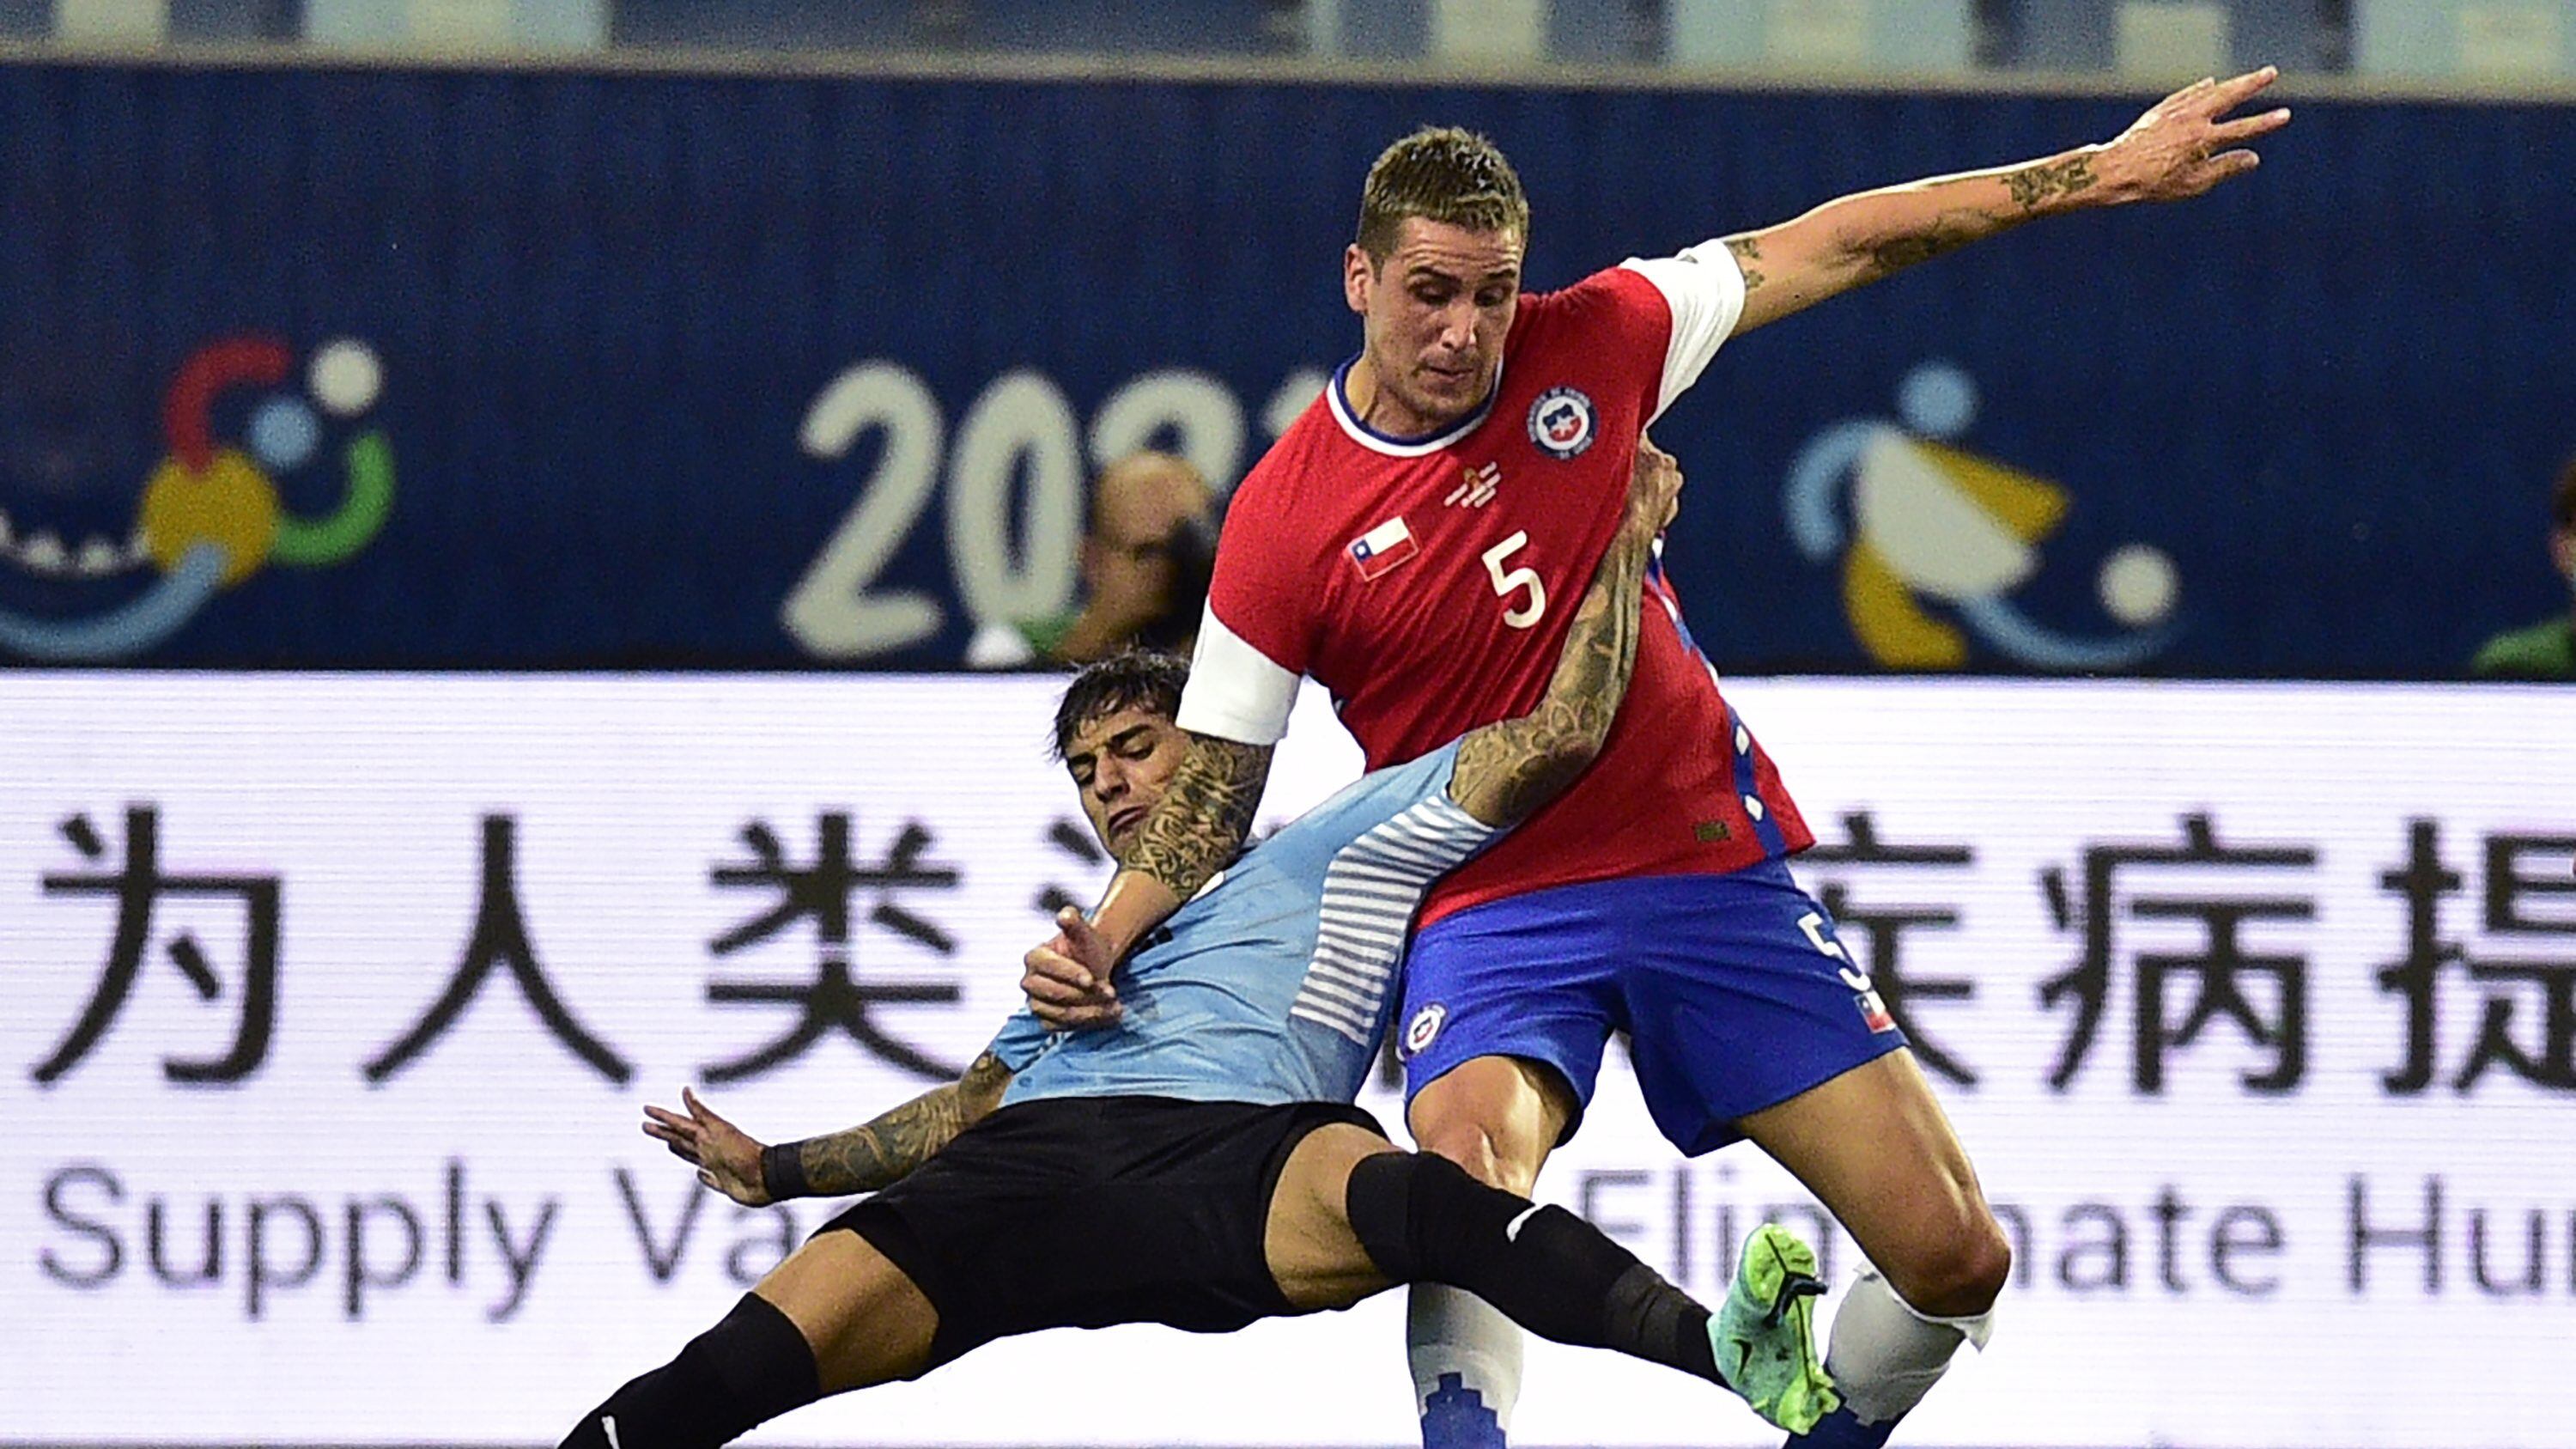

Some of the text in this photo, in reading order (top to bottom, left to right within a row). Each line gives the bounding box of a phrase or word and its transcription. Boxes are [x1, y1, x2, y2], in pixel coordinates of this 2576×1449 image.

[1481, 529, 1546, 630] 5
[1796, 911, 1872, 992] 5
[40, 1158, 562, 1321] Supply
[2348, 1172, 2576, 1295] Hu
